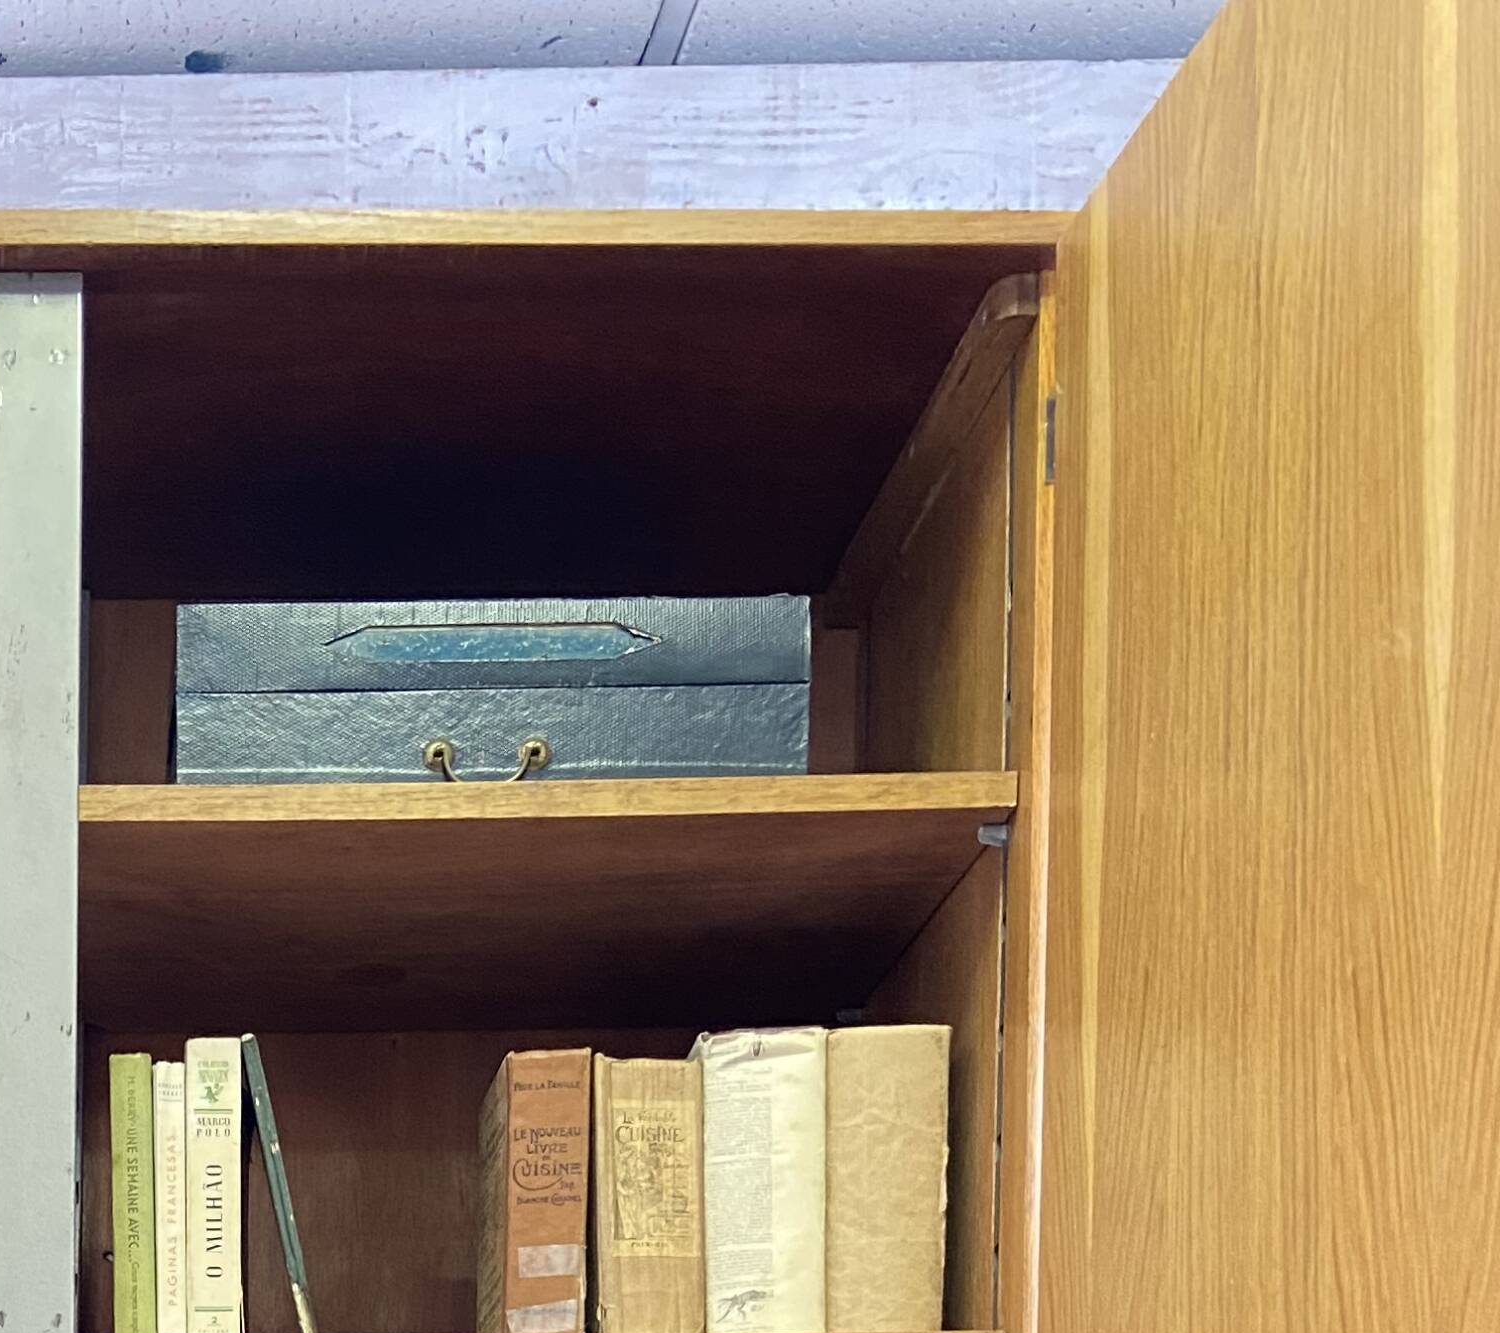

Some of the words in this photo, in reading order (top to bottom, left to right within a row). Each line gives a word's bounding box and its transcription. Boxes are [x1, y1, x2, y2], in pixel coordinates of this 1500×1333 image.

[535, 1082, 545, 1091] LA
[196, 1117, 232, 1127] MARCO
[126, 1128, 138, 1153] UNE
[196, 1128, 231, 1138] POLO
[513, 1128, 528, 1142] LE
[530, 1126, 581, 1144] NOUVEAU
[614, 1124, 685, 1145] CUISINE
[526, 1142, 569, 1155] LIVRE
[512, 1158, 583, 1191] CUISINE
[126, 1159, 139, 1213] SEMAINE
[205, 1266, 223, 1278] O
